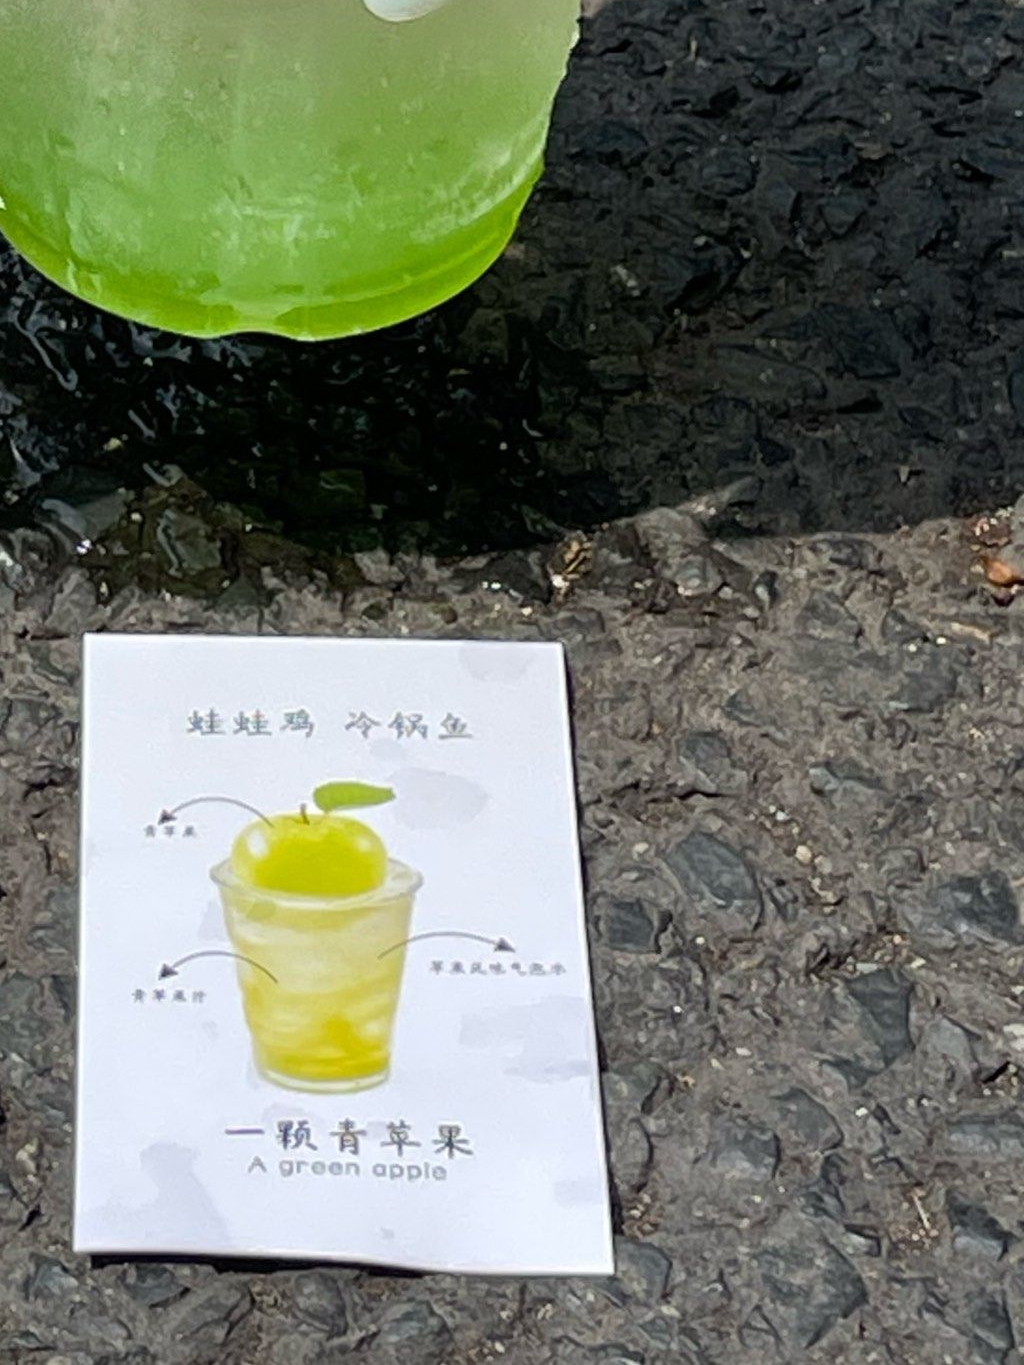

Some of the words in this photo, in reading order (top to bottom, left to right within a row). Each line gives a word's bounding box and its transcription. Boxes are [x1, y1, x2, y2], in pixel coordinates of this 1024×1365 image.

[187, 708, 316, 739] 蛙蛙鸡
[344, 711, 473, 741] 冷锅鱼
[224, 1118, 474, 1159] 一颗青苹果
[248, 1156, 267, 1173] A
[279, 1160, 361, 1178] green
[372, 1161, 447, 1182] apple
